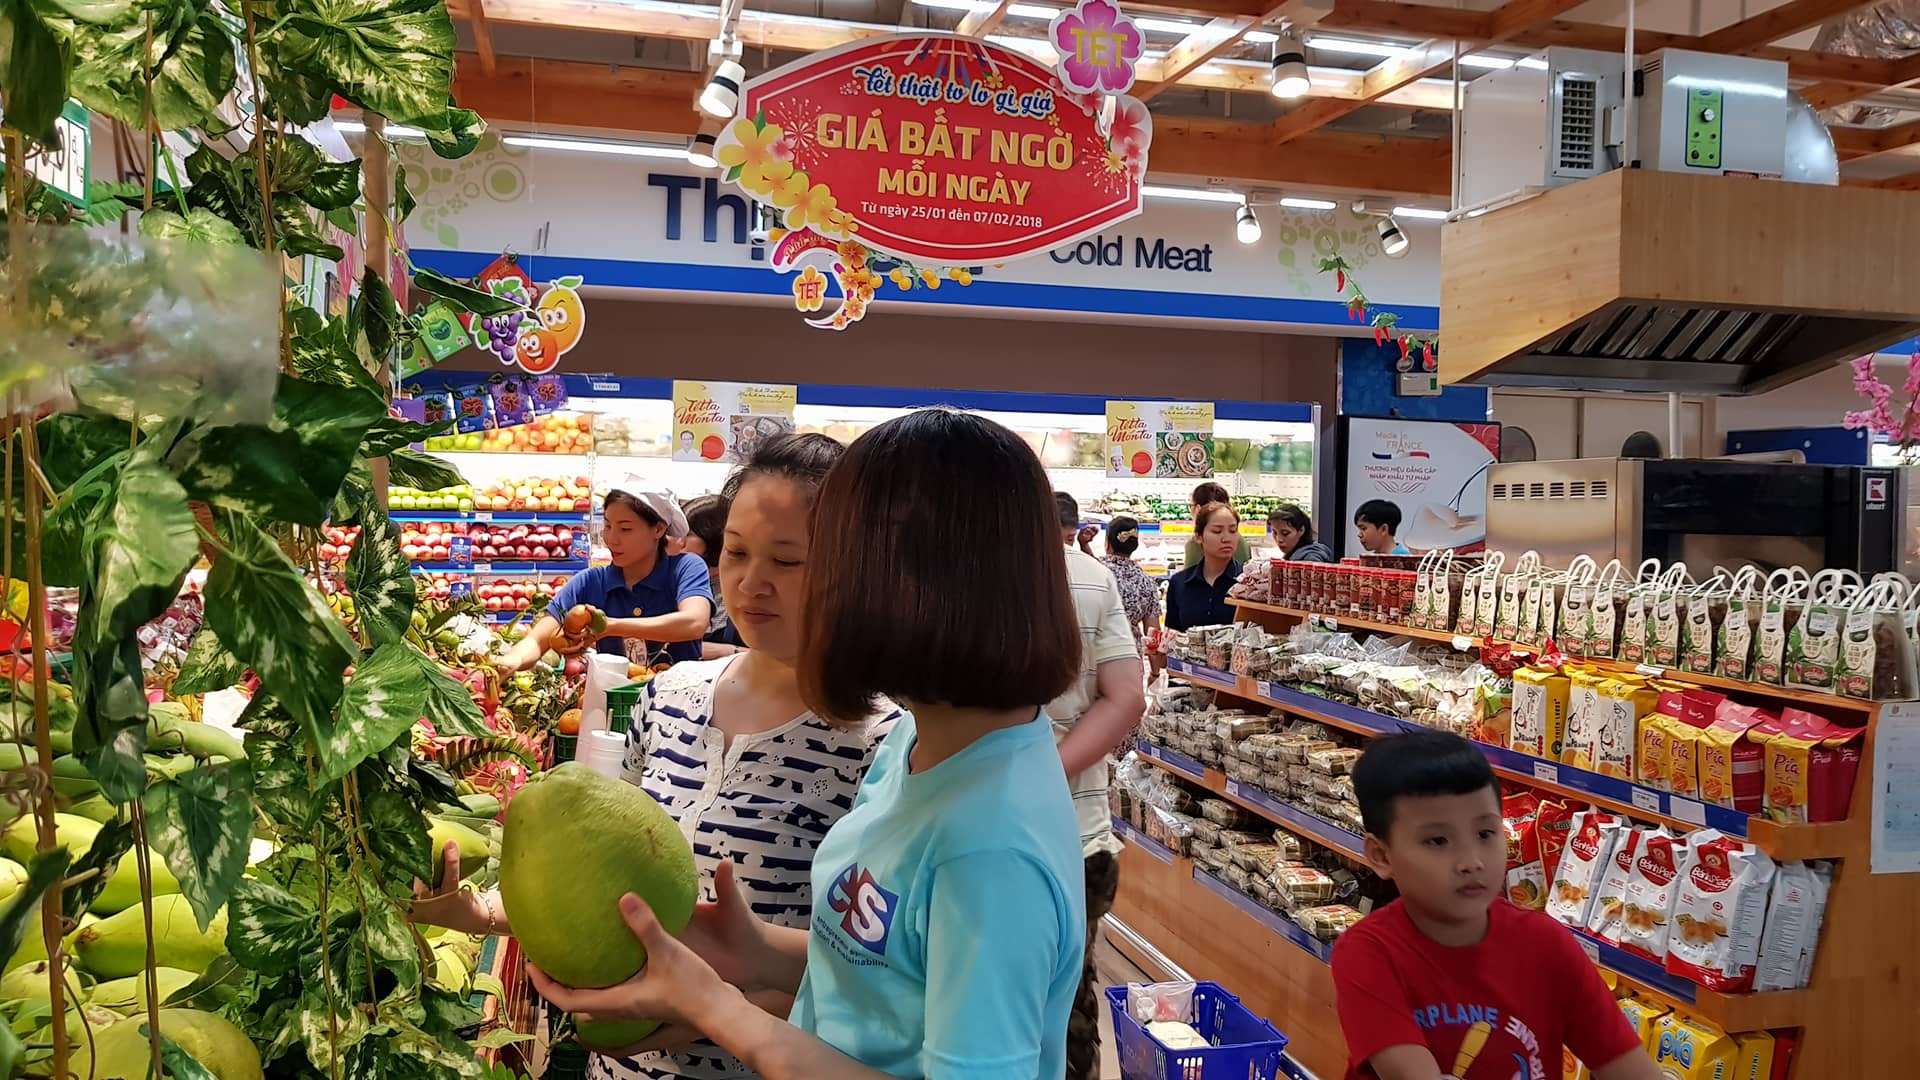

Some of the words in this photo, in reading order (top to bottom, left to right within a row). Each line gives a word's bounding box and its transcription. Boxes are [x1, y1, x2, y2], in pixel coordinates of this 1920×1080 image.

[898, 74, 939, 102] thật
[946, 79, 963, 99] to
[971, 84, 989, 103] lo
[995, 90, 1015, 113] gì
[1021, 90, 1054, 116] giá
[817, 108, 888, 152] GIÁ
[899, 108, 981, 160] BẤT
[991, 128, 1074, 170] NGỜ
[878, 159, 937, 197] MỖI
[946, 171, 1031, 205] NGÀY
[861, 201, 878, 214] Từ
[880, 204, 909, 219] ngày
[911, 206, 946, 219] 25/01
[949, 208, 970, 221] đến
[973, 211, 1042, 227] 07/02/2018
[1135, 236, 1212, 272] Meat
[1386, 440, 1423, 449] FRANCE
